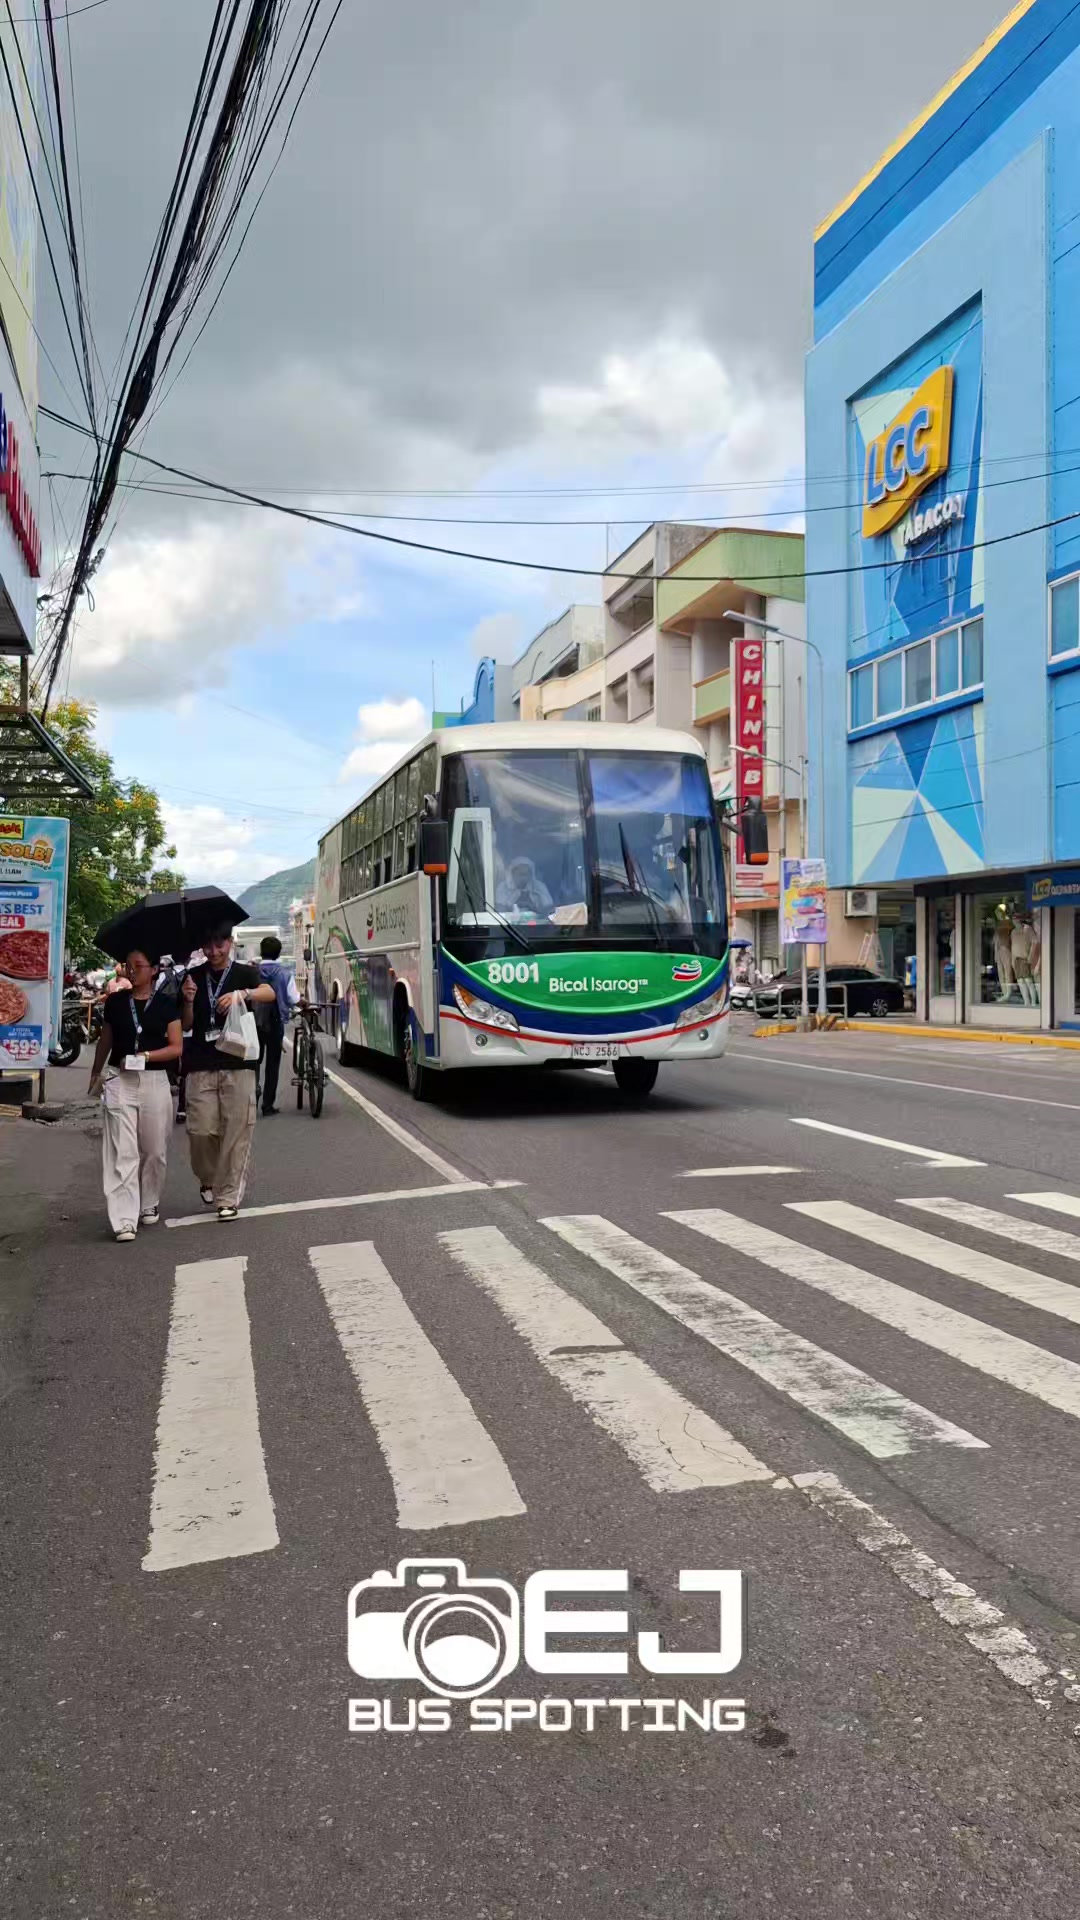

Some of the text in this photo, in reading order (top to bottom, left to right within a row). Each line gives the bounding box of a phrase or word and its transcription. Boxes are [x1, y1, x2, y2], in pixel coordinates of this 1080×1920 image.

[866, 407, 930, 507] LCC
[742, 645, 762, 785] CHINAB
[14, 903, 45, 915] BEST
[488, 962, 540, 984] 8001
[549, 977, 588, 993] Bicol
[574, 1046, 591, 1057] NCJ
